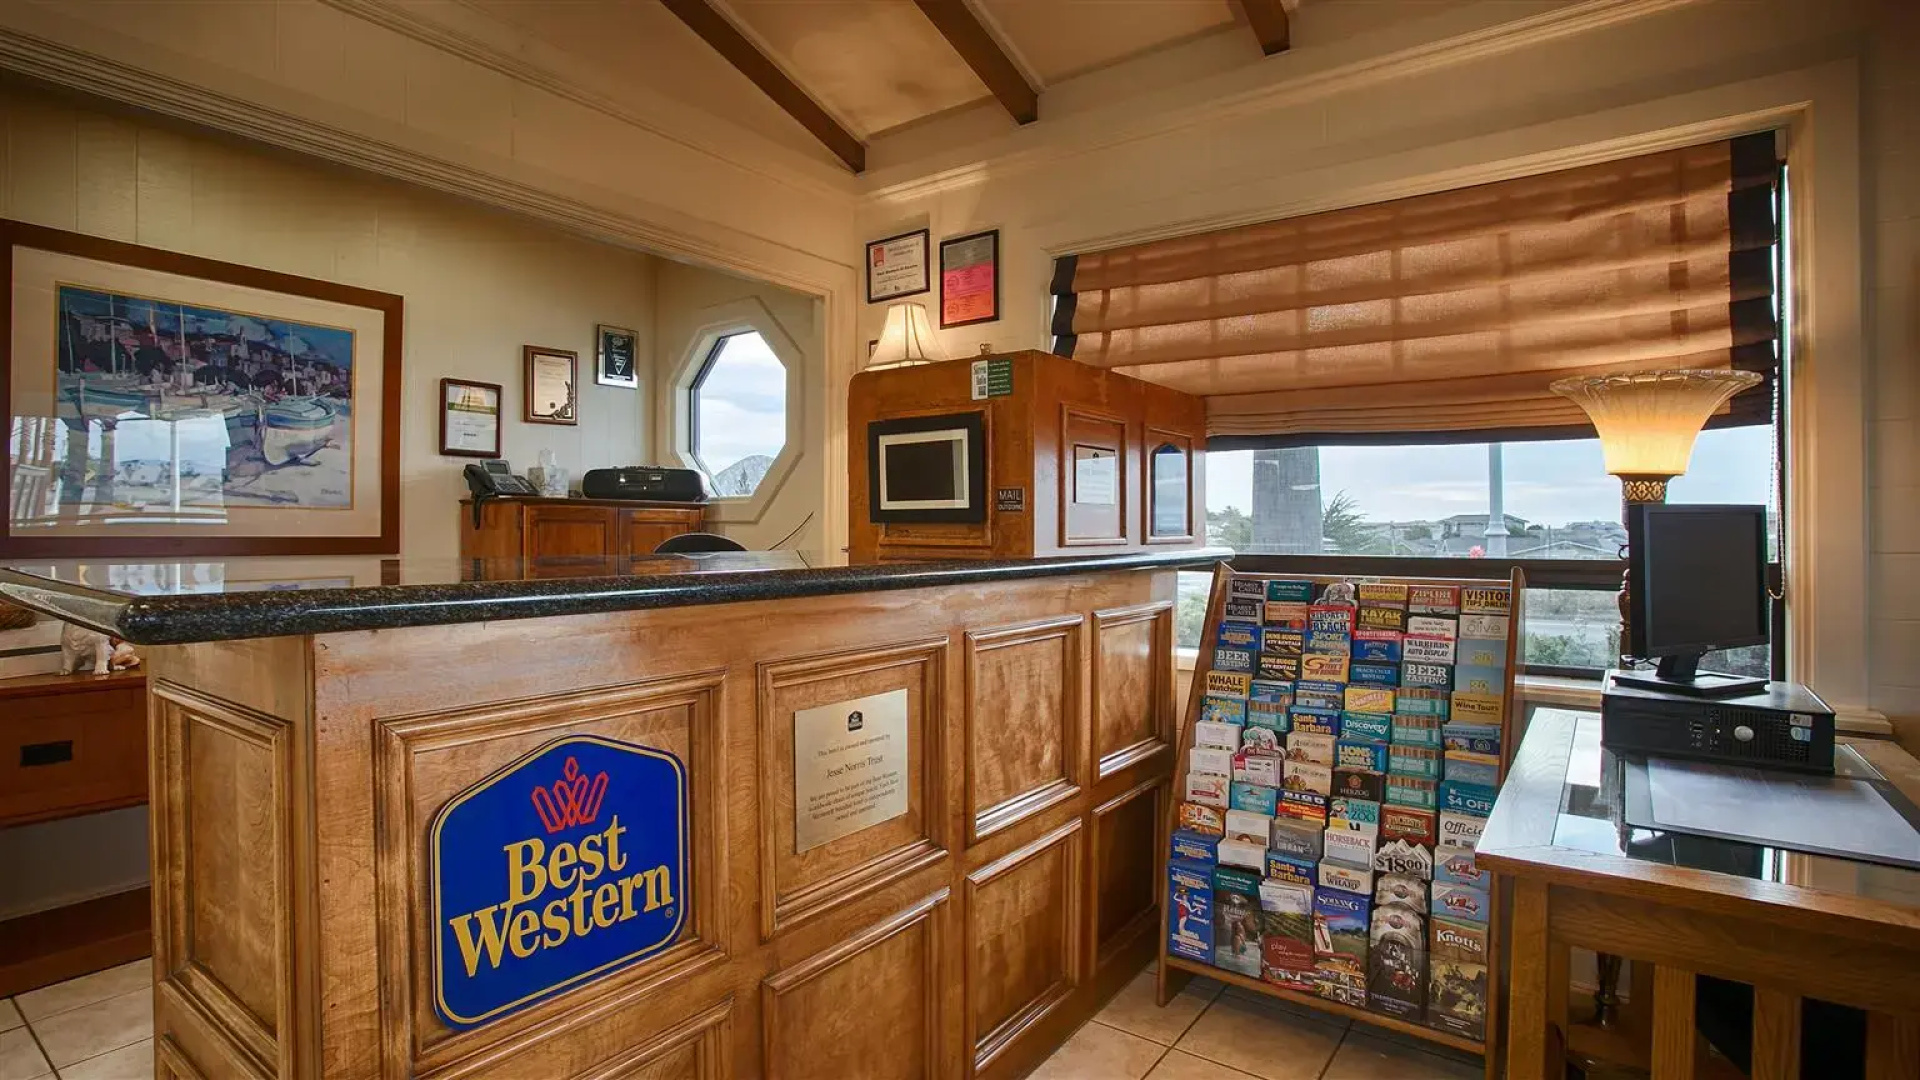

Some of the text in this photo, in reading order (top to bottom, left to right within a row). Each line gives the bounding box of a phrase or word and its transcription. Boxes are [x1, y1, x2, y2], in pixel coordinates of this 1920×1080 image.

[999, 489, 1022, 501] MAIL
[1465, 599, 1482, 607] TIPS
[1360, 608, 1402, 619] KAYAK
[1312, 621, 1347, 632] BEACH
[1216, 649, 1250, 662] BEER
[1407, 647, 1449, 657] AUTO DISPLAY
[1215, 659, 1250, 668] TASTING
[1406, 664, 1448, 678] BEER
[1208, 674, 1243, 687] WHALE
[1405, 674, 1448, 685] TASTING
[1208, 683, 1243, 696] Watching
[1454, 700, 1500, 712] Wine Tours
[1293, 713, 1317, 724] Santa
[1293, 723, 1332, 733] Barbara
[826, 764, 843, 778] Jesse
[867, 753, 883, 766] Trust
[1465, 798, 1492, 811] OFF
[1351, 809, 1376, 822] ZOO
[1325, 832, 1371, 847] HORSEBACK
[504, 815, 627, 905] Best
[1269, 859, 1296, 873] Santa
[1269, 867, 1311, 885] Barbara
[449, 865, 675, 978] Western
[1436, 929, 1482, 952] Knott's
